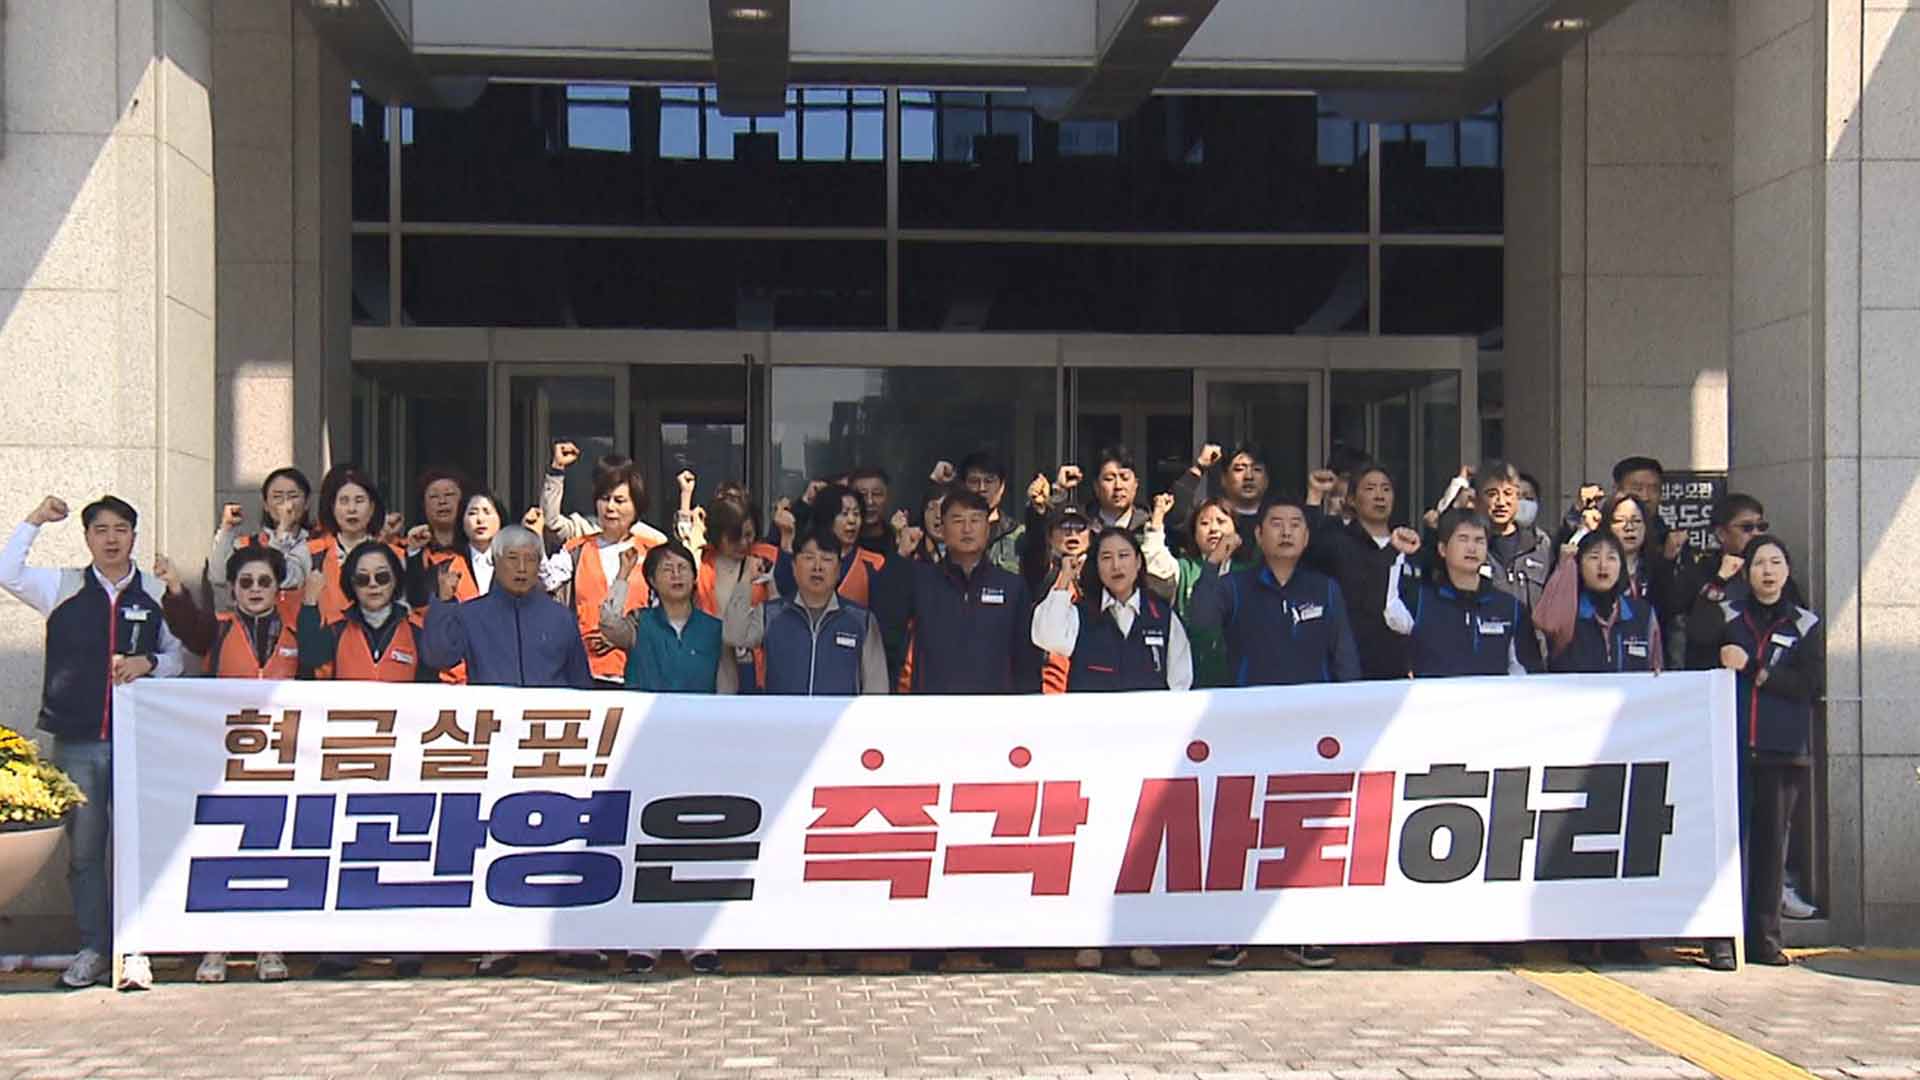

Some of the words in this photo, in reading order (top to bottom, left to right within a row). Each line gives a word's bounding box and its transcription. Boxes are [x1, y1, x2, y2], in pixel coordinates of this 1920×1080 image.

[185, 790, 762, 913] 김관영은
[803, 780, 1089, 899] 즉각
[1113, 761, 1675, 895] 사퇴하라
